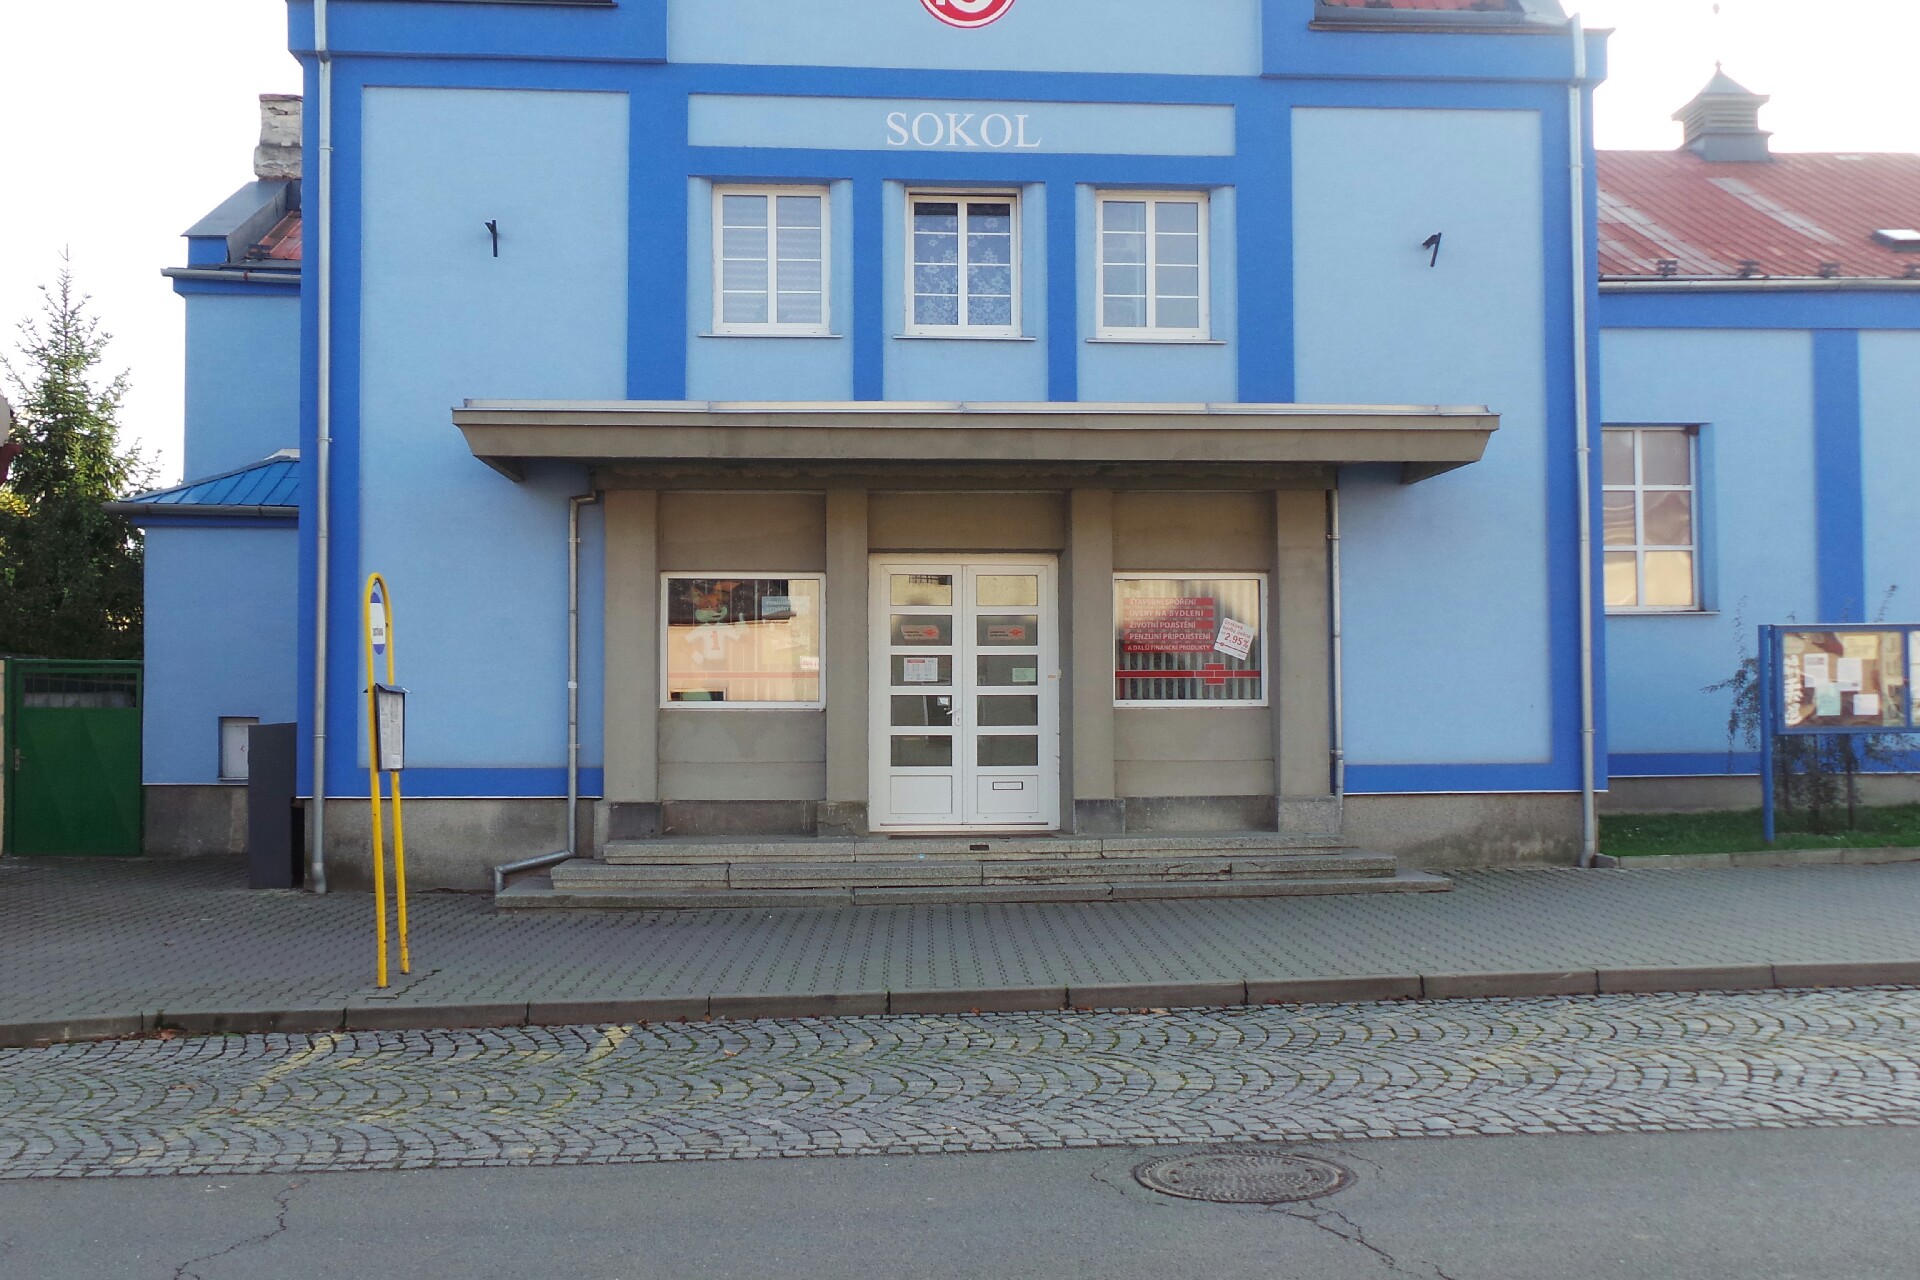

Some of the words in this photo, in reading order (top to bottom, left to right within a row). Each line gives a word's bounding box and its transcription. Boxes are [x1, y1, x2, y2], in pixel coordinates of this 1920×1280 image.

[886, 112, 1042, 148] SOKOL
[1155, 609, 1167, 617] NA
[1169, 608, 1204, 617] BYDLENÍ
[1129, 620, 1159, 629] ŽIVOTNÍ
[1160, 620, 1196, 629] POJIŠTĚNÍ
[711, 631, 720, 650] 1
[1129, 632, 1161, 640] PENZIJNÍ
[1162, 632, 1211, 640] PŘIPOJIŠTĚNÍ
[1132, 643, 1150, 651] DALŠÍ
[1151, 643, 1178, 651] FINANČNÍ
